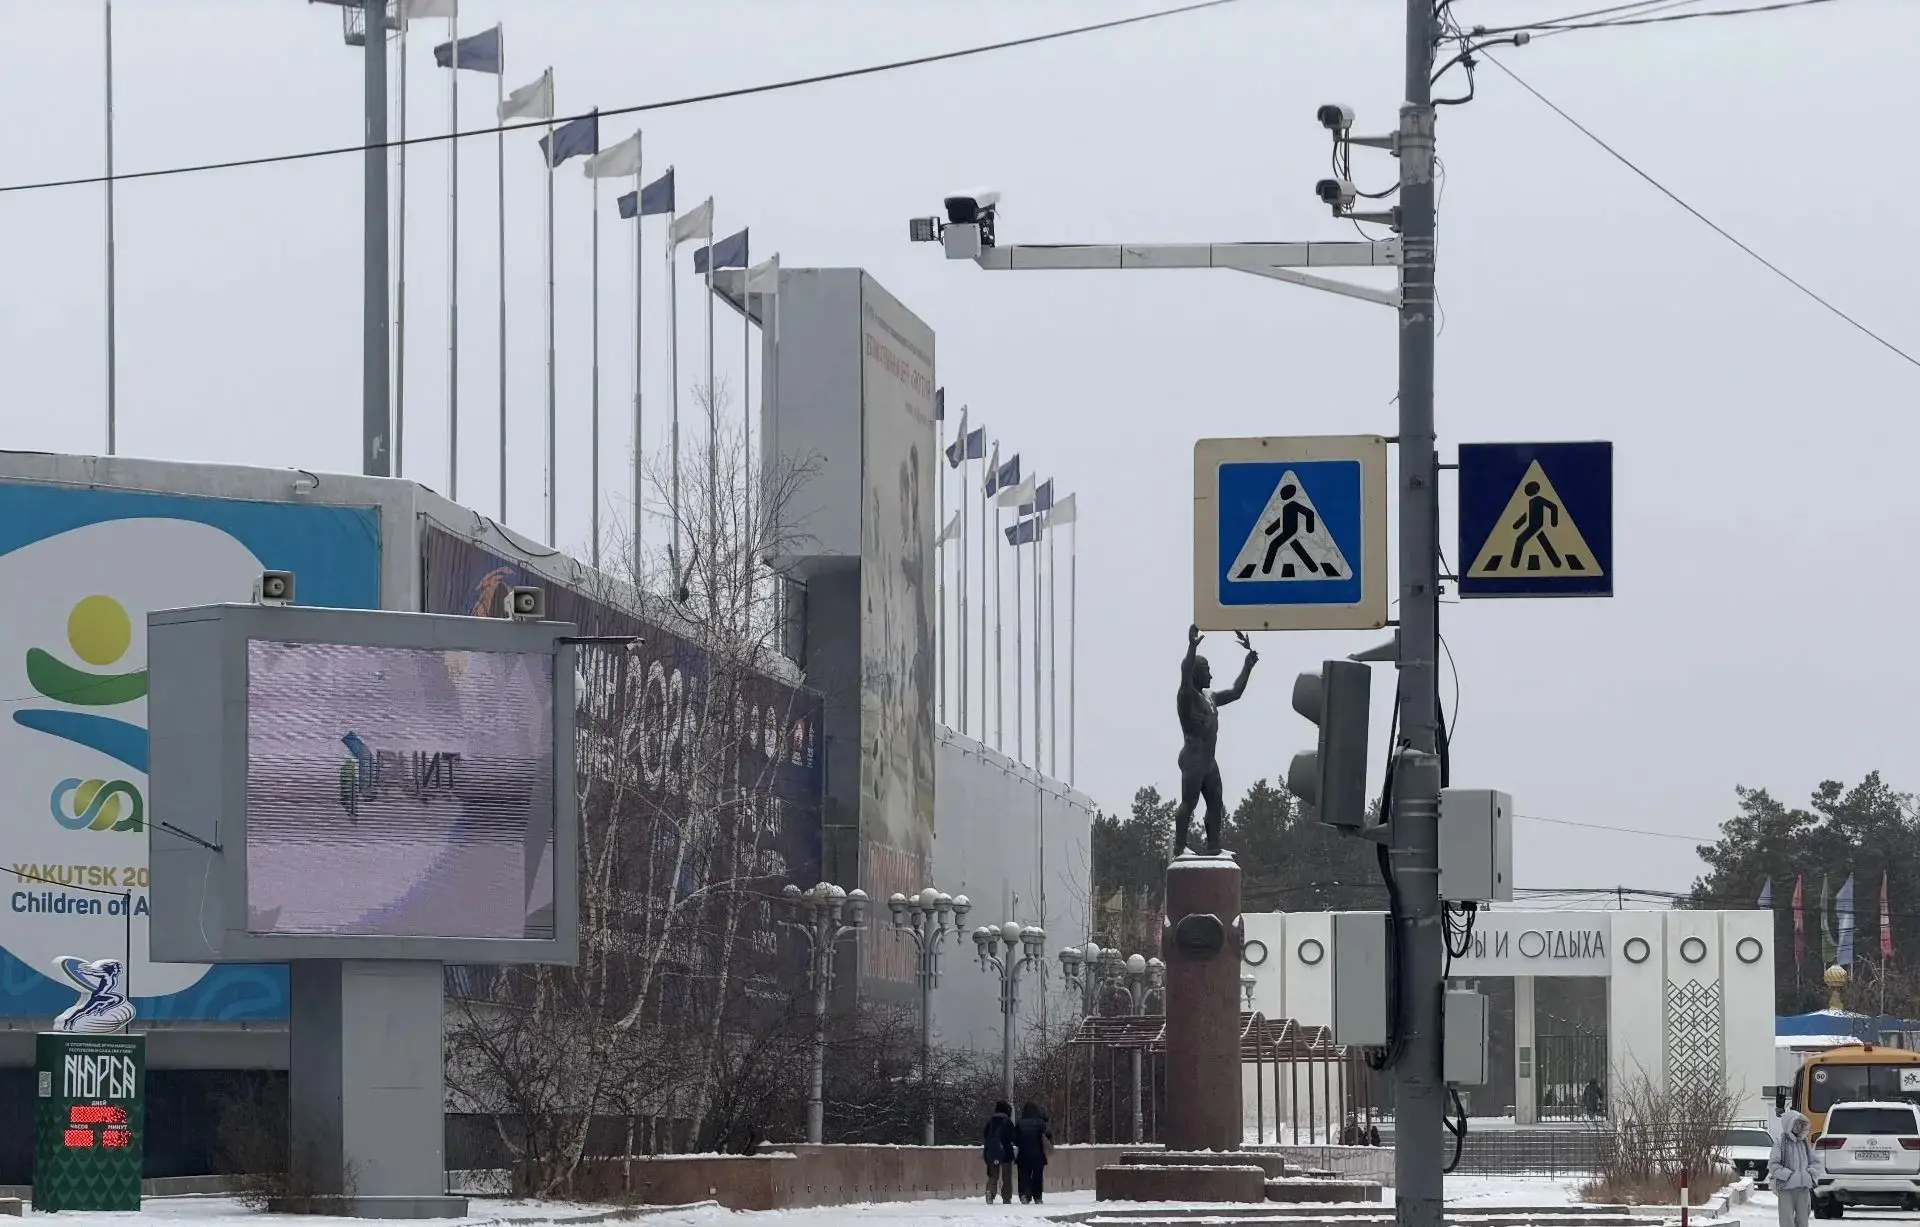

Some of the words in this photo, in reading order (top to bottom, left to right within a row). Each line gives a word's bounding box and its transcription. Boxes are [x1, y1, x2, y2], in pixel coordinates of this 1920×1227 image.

[13, 863, 117, 886] YAKUTSK
[11, 891, 101, 915] Children
[107, 895, 131, 915] of
[1495, 931, 1508, 958] И
[1518, 930, 1604, 958] ОТДЫХА
[64, 1054, 136, 1099] НЮРБА
